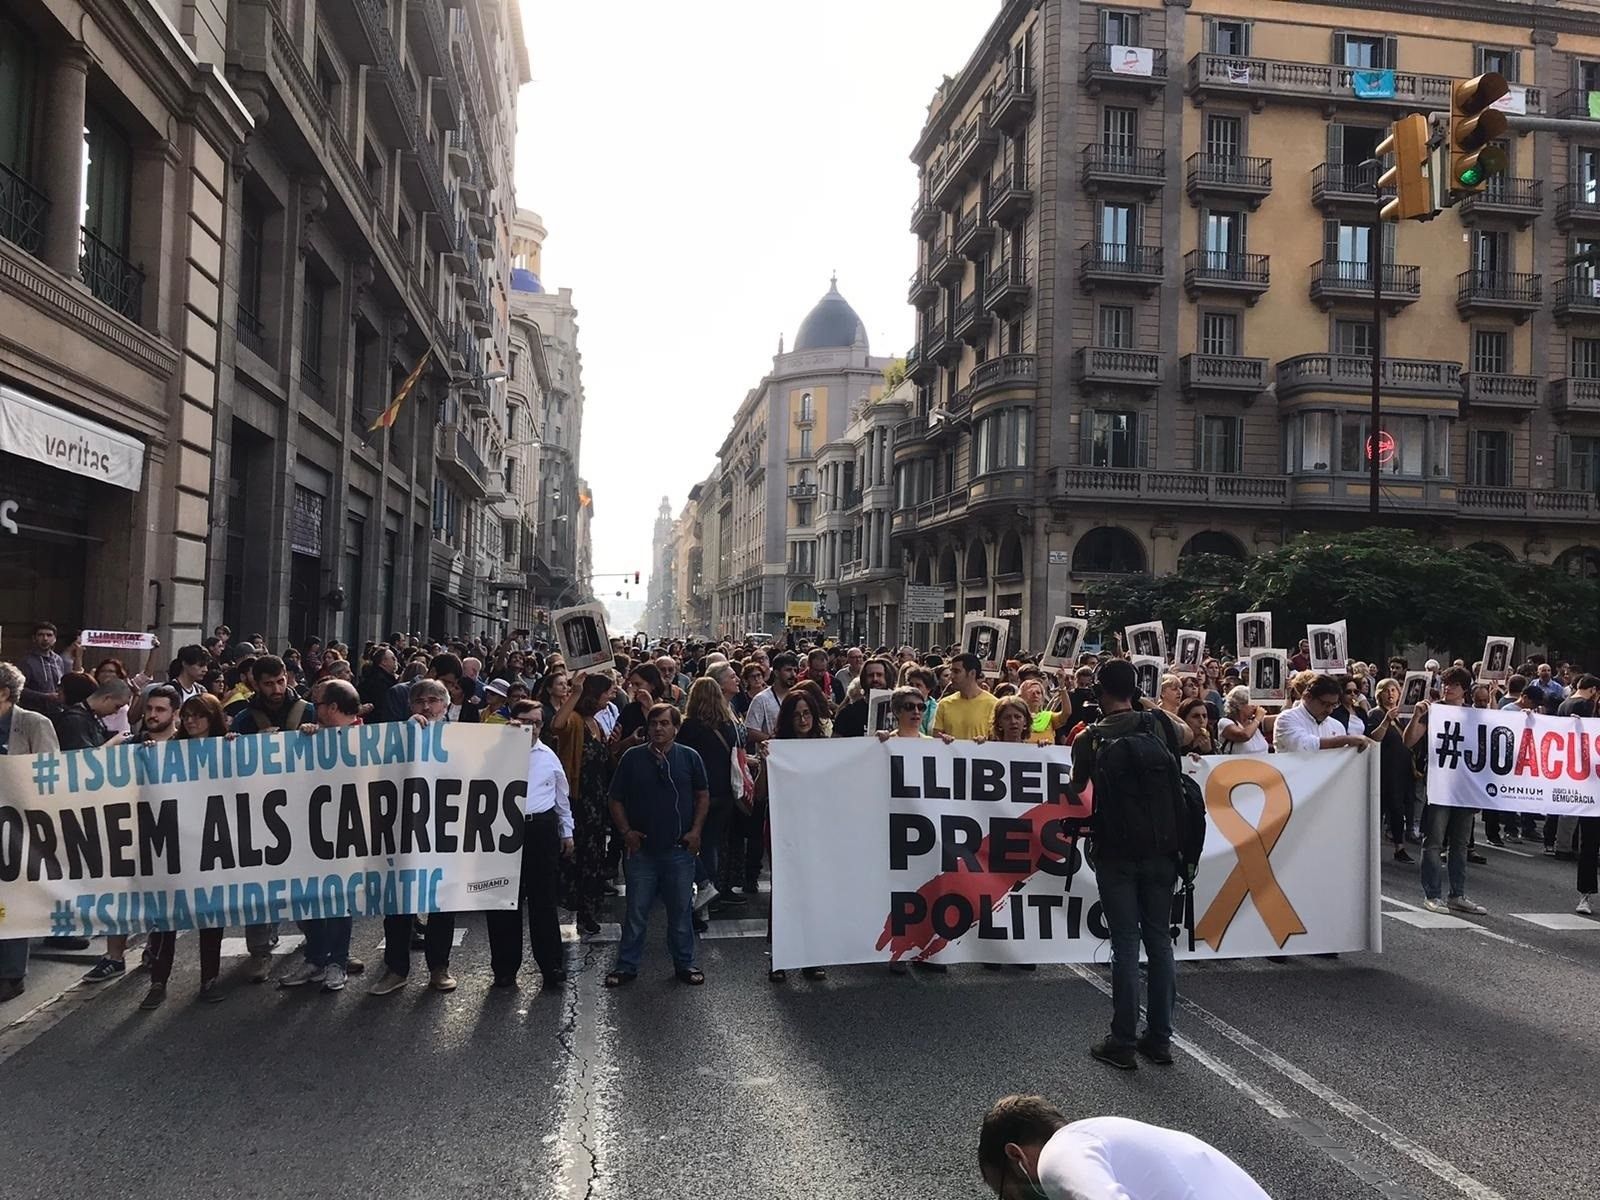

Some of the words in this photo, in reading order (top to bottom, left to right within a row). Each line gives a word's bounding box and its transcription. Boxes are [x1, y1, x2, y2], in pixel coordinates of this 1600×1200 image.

[45, 433, 110, 474] veritas
[890, 755, 1083, 805] LLIBER
[1500, 784, 1543, 796] ÒMNIUM
[1552, 793, 1595, 804] DEMOCRÀCIA
[200, 789, 292, 871] ALS
[308, 777, 529, 860] CARRERS
[889, 813, 1099, 877] PRES
